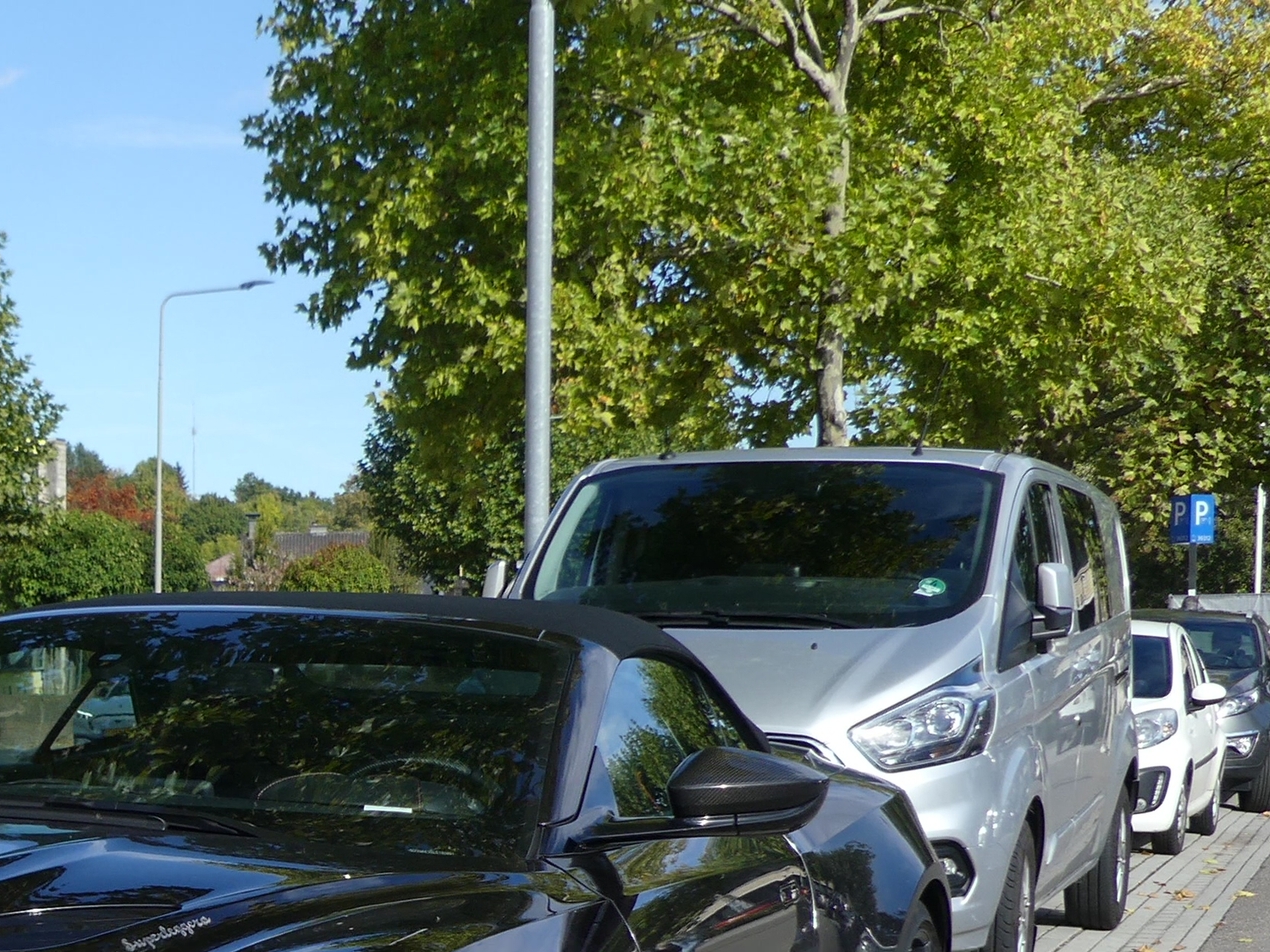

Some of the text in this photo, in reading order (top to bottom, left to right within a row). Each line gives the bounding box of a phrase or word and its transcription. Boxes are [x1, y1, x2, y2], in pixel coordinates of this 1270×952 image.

[1175, 502, 1186, 526] P
[1196, 501, 1208, 525] P
[121, 916, 211, 952] Superleggera
